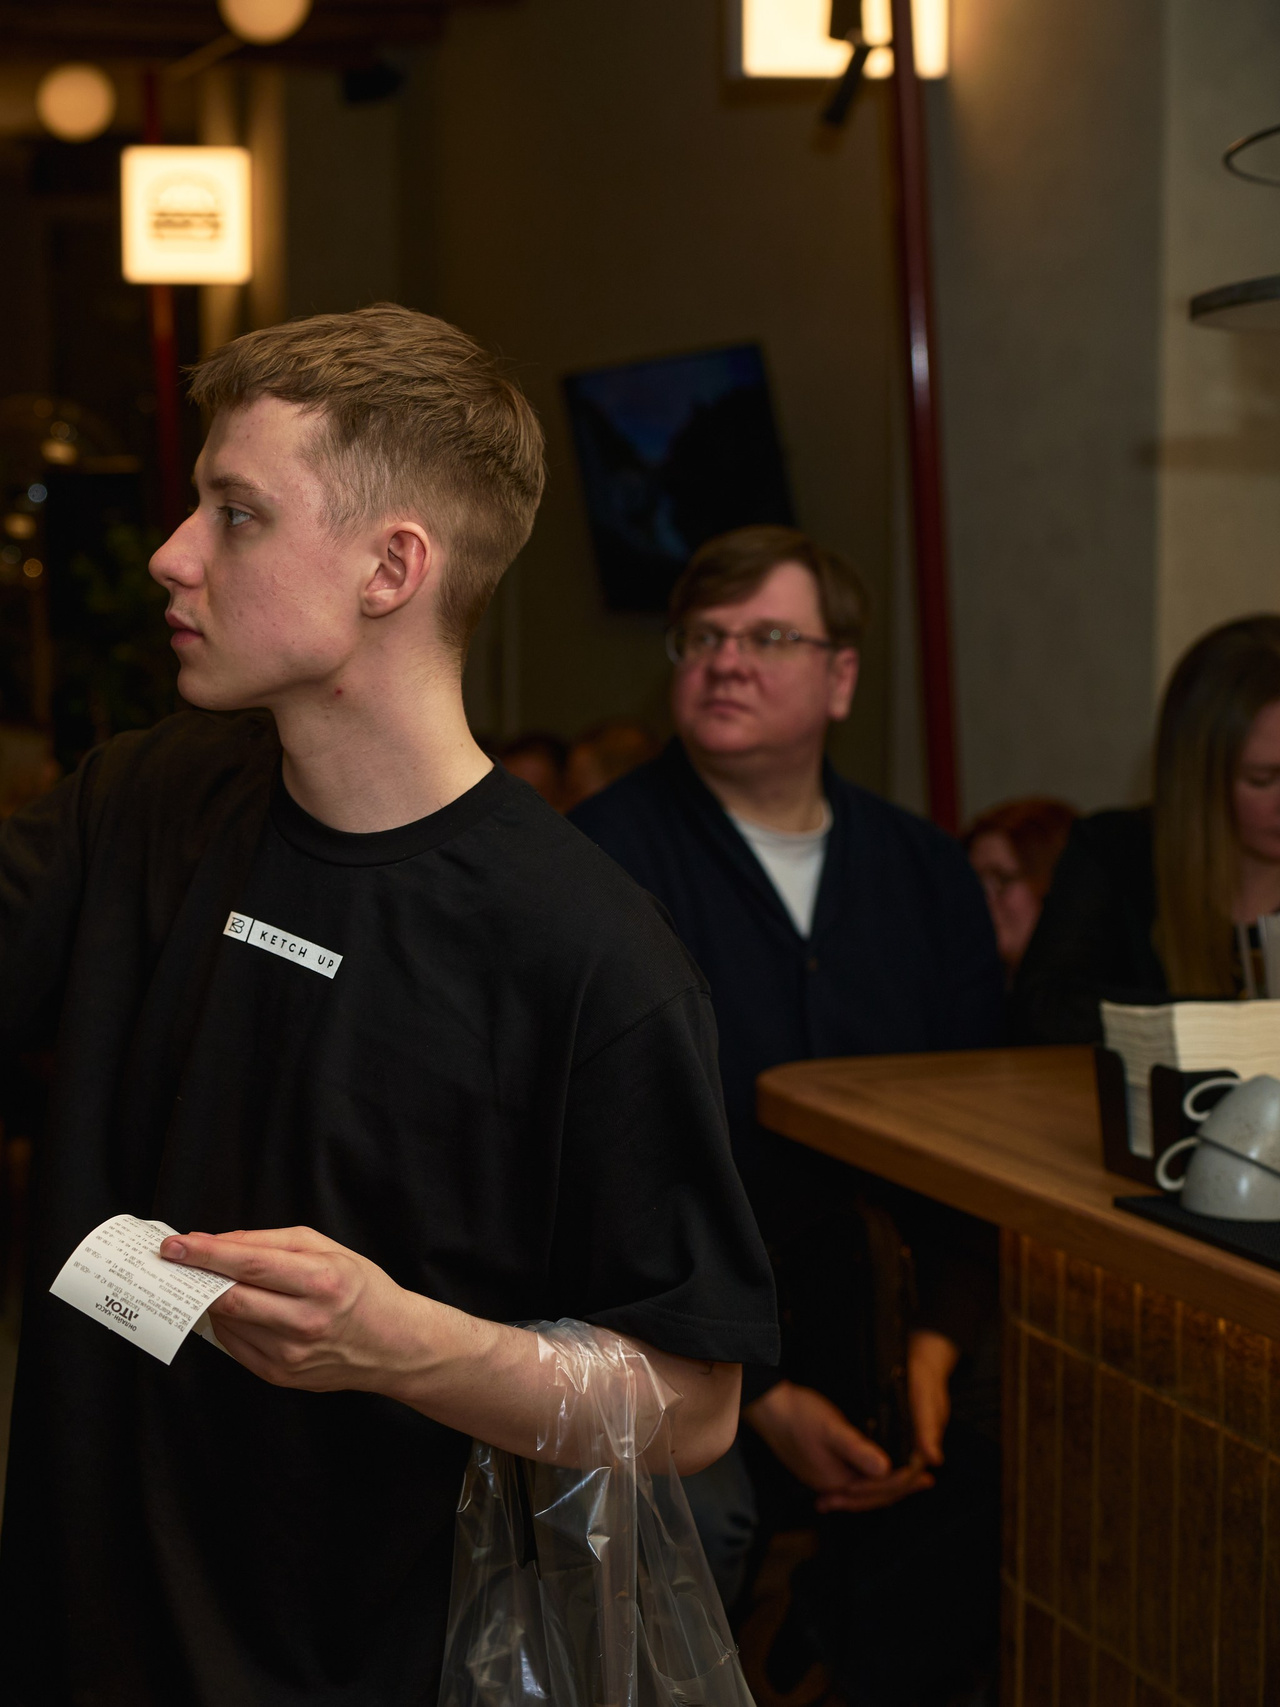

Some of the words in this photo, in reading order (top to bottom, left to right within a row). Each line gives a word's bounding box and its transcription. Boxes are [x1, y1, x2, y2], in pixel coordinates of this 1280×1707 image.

[259, 930, 308, 958] KETCH
[317, 954, 335, 969] UP
[101, 1294, 139, 1323] АТОЛ
